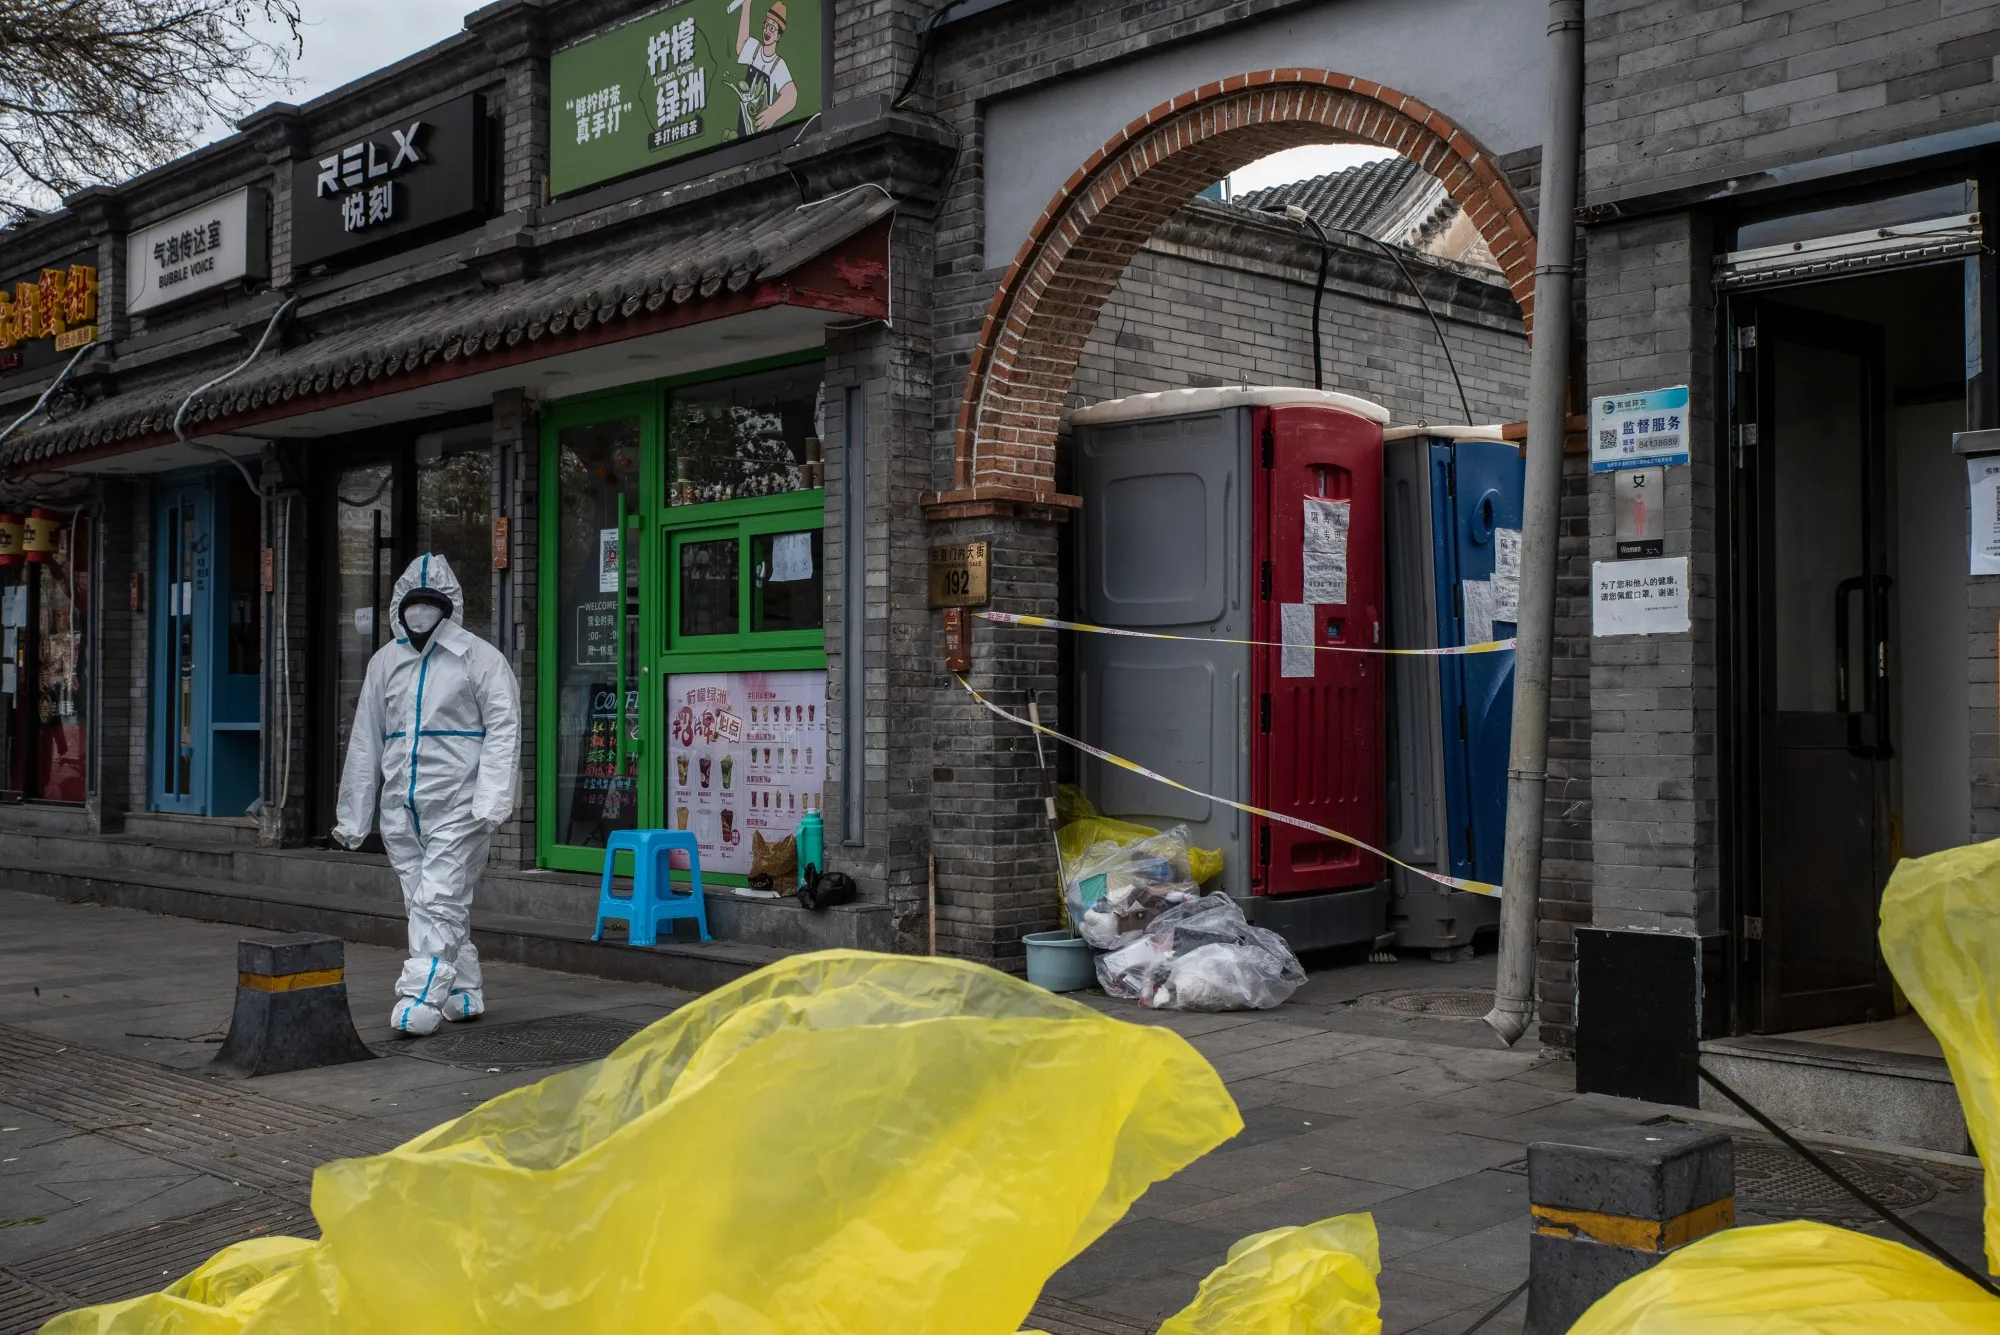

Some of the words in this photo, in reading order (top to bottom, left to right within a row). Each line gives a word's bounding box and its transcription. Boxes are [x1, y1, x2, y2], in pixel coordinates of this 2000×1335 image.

[647, 17, 696, 76] 柠檬
[654, 71, 676, 88] Lemon
[677, 61, 695, 76] Oasis
[656, 67, 706, 128] 绿洲
[653, 119, 698, 147] 手打柠檬茶
[317, 121, 421, 198] RELX
[342, 180, 393, 232] 悦刻
[153, 219, 221, 269] 气泡传达室
[158, 267, 188, 289] BUBBLE
[190, 256, 214, 276] VOICE
[1616, 398, 1647, 409] 东城环卫
[1622, 415, 1681, 436] 监督服务
[1622, 446, 1635, 454] 电话
[1638, 437, 1678, 449] 84138689
[1633, 474, 1645, 488] 女
[931, 545, 985, 562] 东直门内大街
[1620, 545, 1642, 554] Women
[945, 570, 969, 596] 192
[584, 600, 617, 611] WELCOME
[587, 615, 614, 627] 营业时间
[686, 686, 727, 706] 柠檬绿洲
[718, 713, 740, 738] 必点
